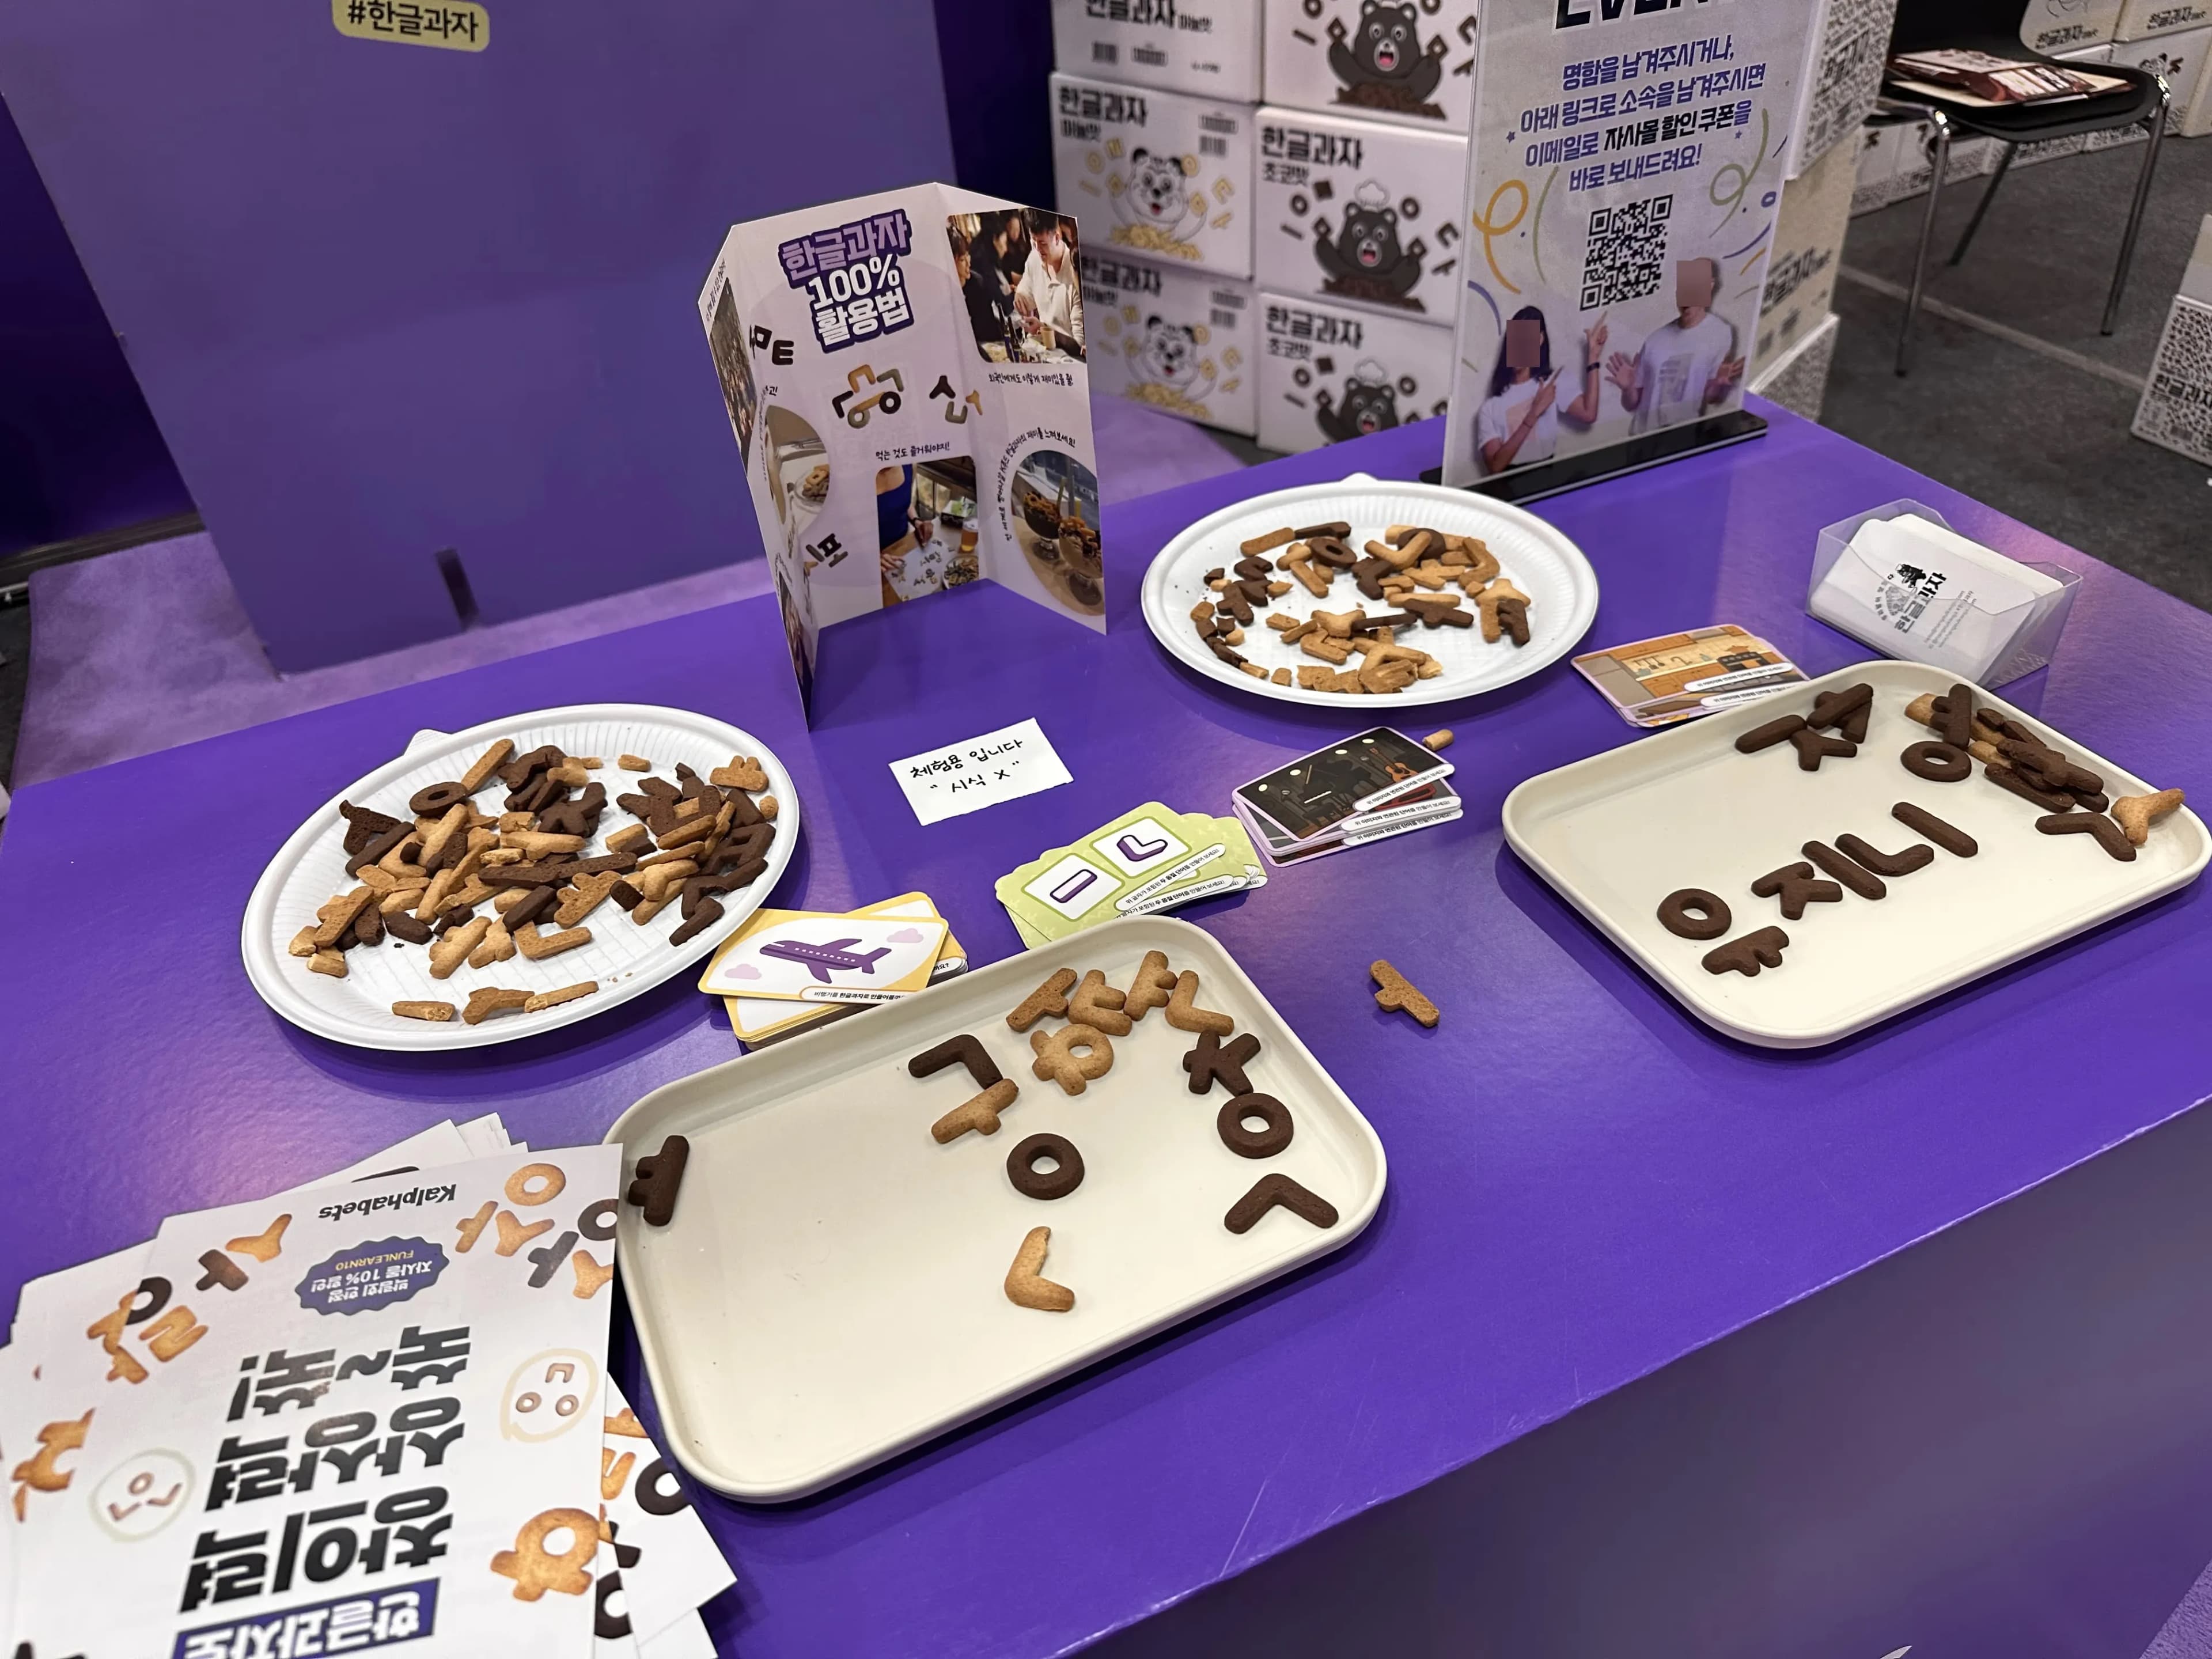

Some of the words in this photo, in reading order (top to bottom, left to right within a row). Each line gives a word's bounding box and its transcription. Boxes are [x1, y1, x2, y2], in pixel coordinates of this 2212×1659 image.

[347, 0, 479, 43] #한글과자
[1563, 56, 1619, 91] 명함을
[1622, 35, 1734, 82] 남겨주시거나,
[1521, 103, 1559, 134] 아래
[1562, 93, 1617, 127] 링크로
[1619, 81, 1675, 114] 소속을
[1677, 63, 1766, 104] 남겨주시면
[1262, 126, 1363, 170] 한글과자
[1525, 131, 1599, 166] 이메일로
[1604, 119, 1659, 151] 자사몰
[1569, 165, 1605, 192] 바로
[1607, 143, 1703, 184] 보내드려요!
[782, 213, 908, 281] 한글과자
[808, 253, 900, 310] 100%
[815, 287, 910, 346] 활용법
[1267, 306, 1362, 349] 한글과자
[876, 450, 891, 461] 먹는
[893, 448, 908, 459] 것도
[910, 441, 950, 457] 즐거워야지!
[910, 755, 964, 778] 체험용
[969, 739, 1023, 762] 입니다
[318, 1184, 457, 1222] Kalphabets
[335, 1249, 415, 1271] FUNLEARN10
[346, 1268, 380, 1286] 10%
[385, 1260, 433, 1279] 자사몰
[311, 1275, 342, 1293] 할인
[328, 1286, 359, 1304] 한정
[362, 1279, 408, 1297] 박람회
[204, 1396, 466, 1512] 상상력
[179, 1485, 453, 1612] 창의력
